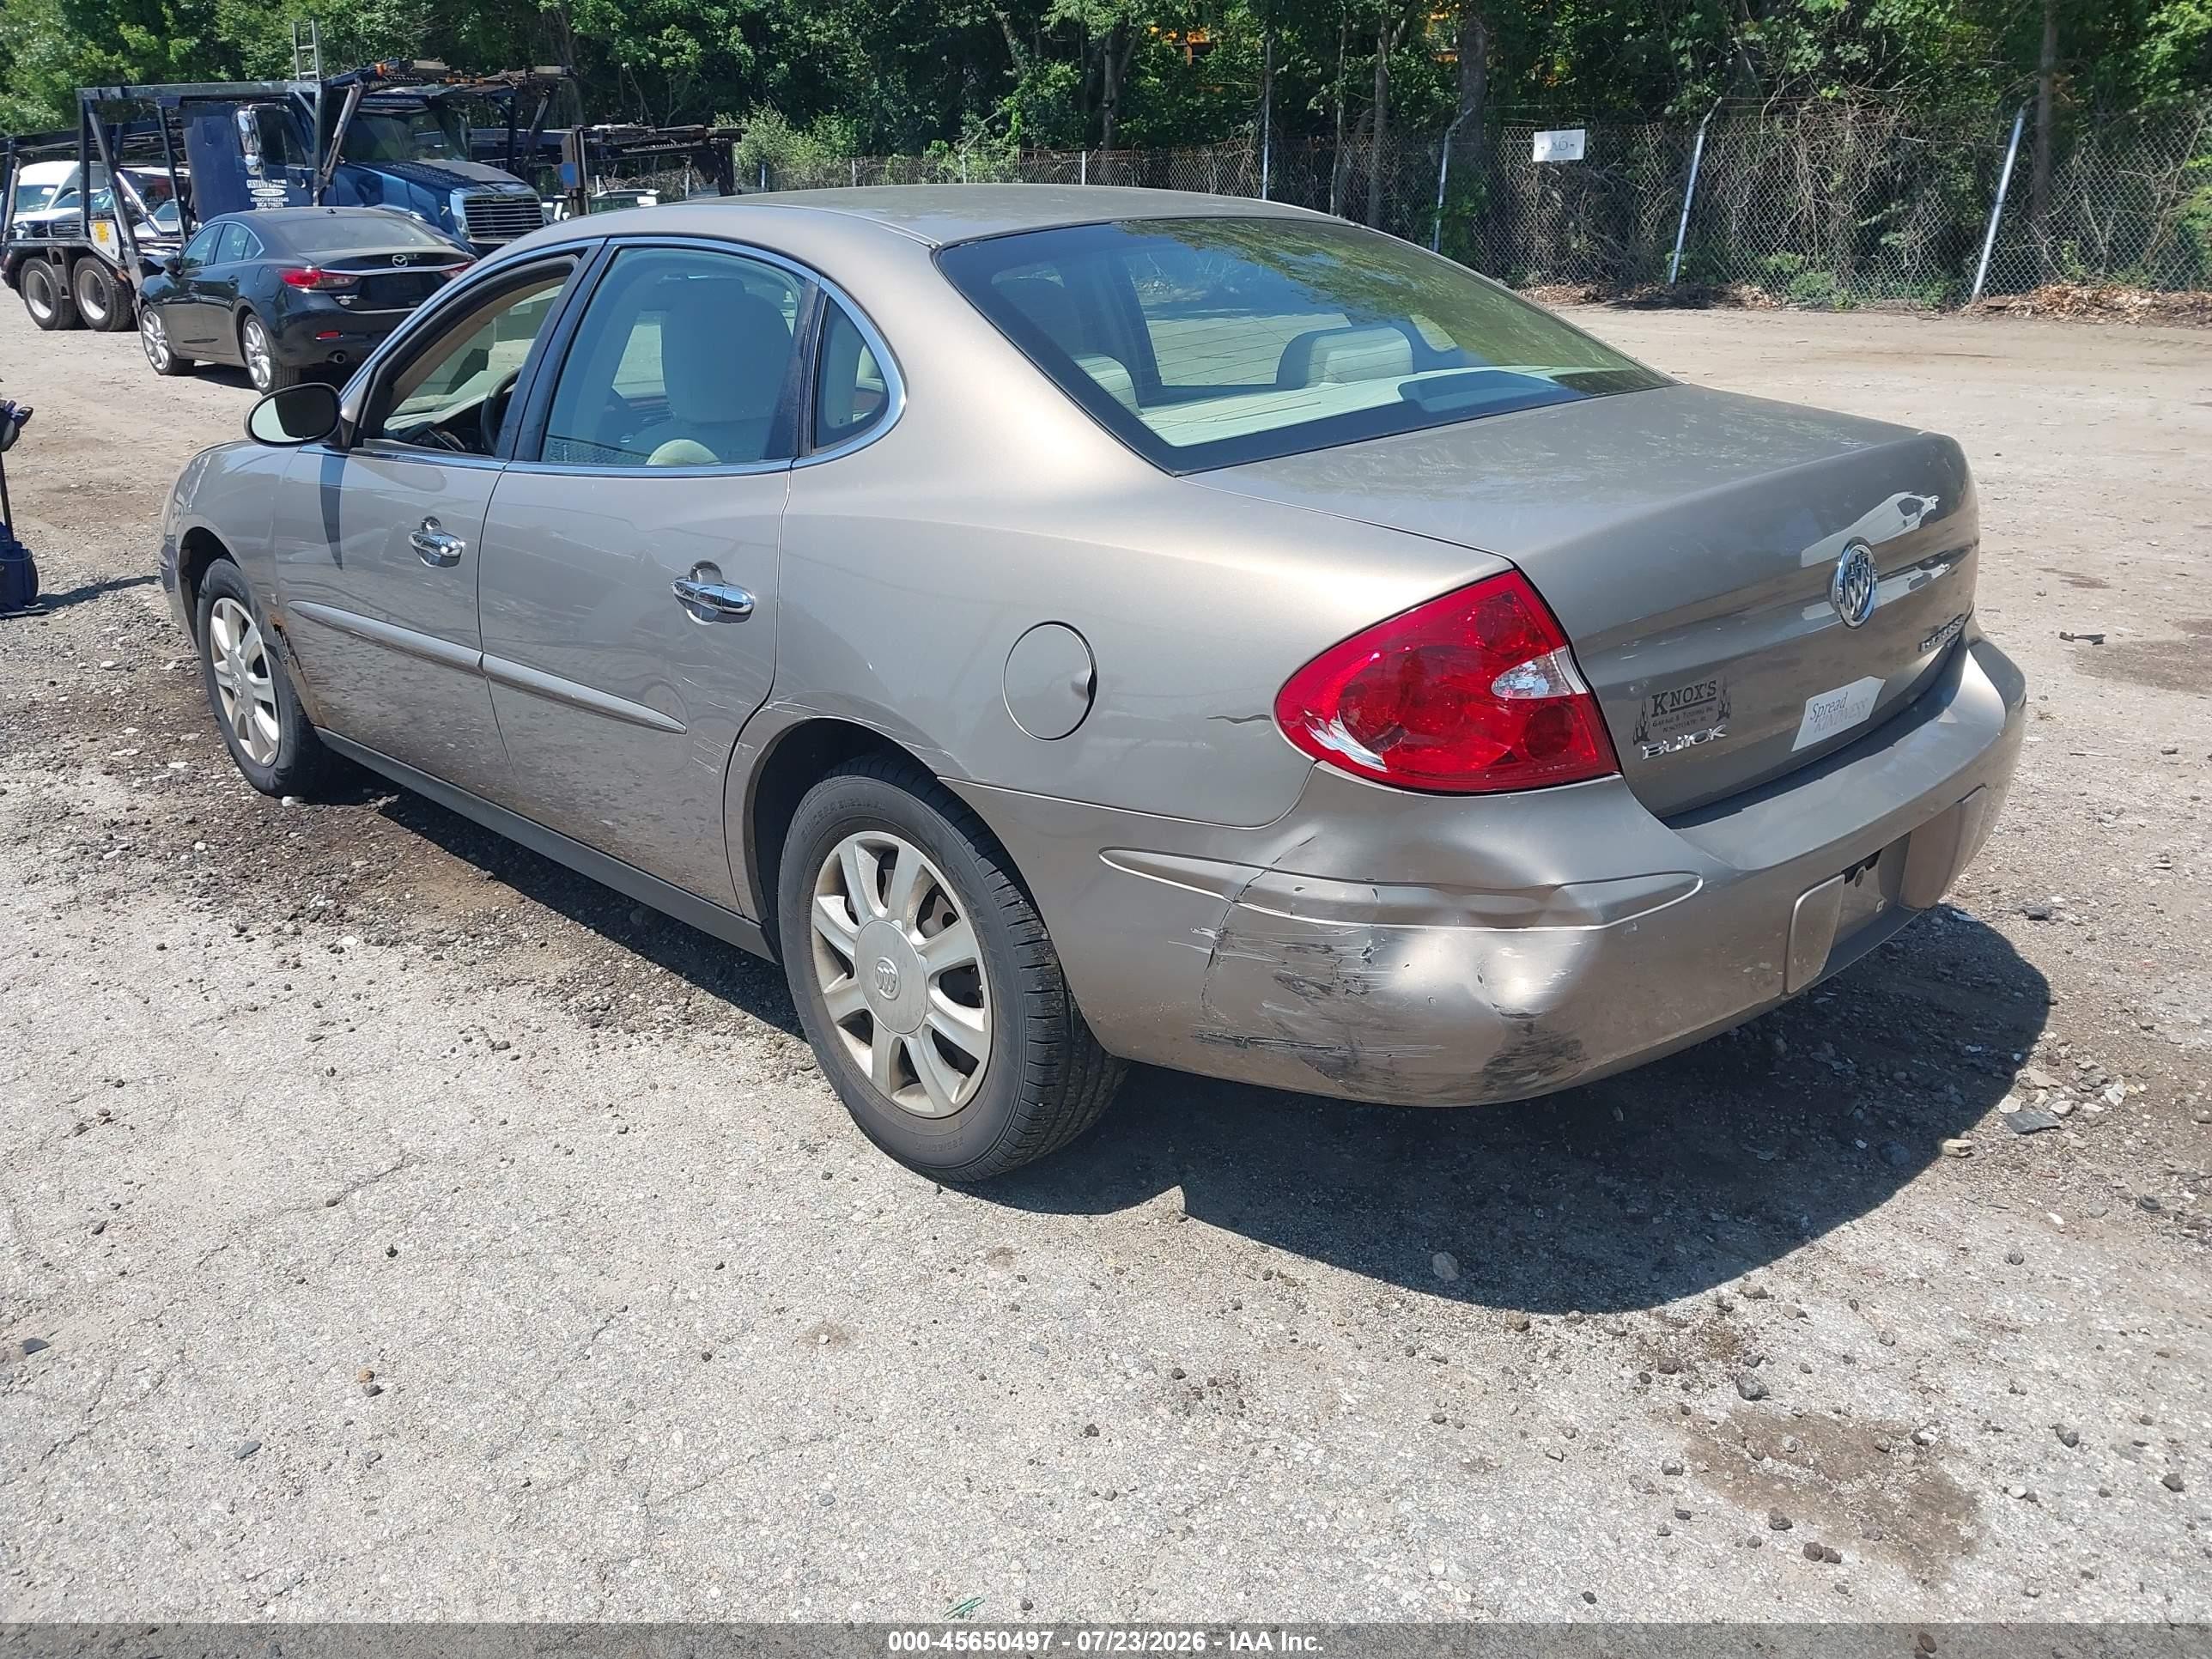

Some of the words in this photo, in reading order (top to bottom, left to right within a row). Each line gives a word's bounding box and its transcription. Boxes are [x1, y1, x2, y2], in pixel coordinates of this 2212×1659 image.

[1651, 680, 1717, 717] KNOX'S
[1810, 690, 1848, 722] Spread
[1642, 724, 1727, 760] BUICK
